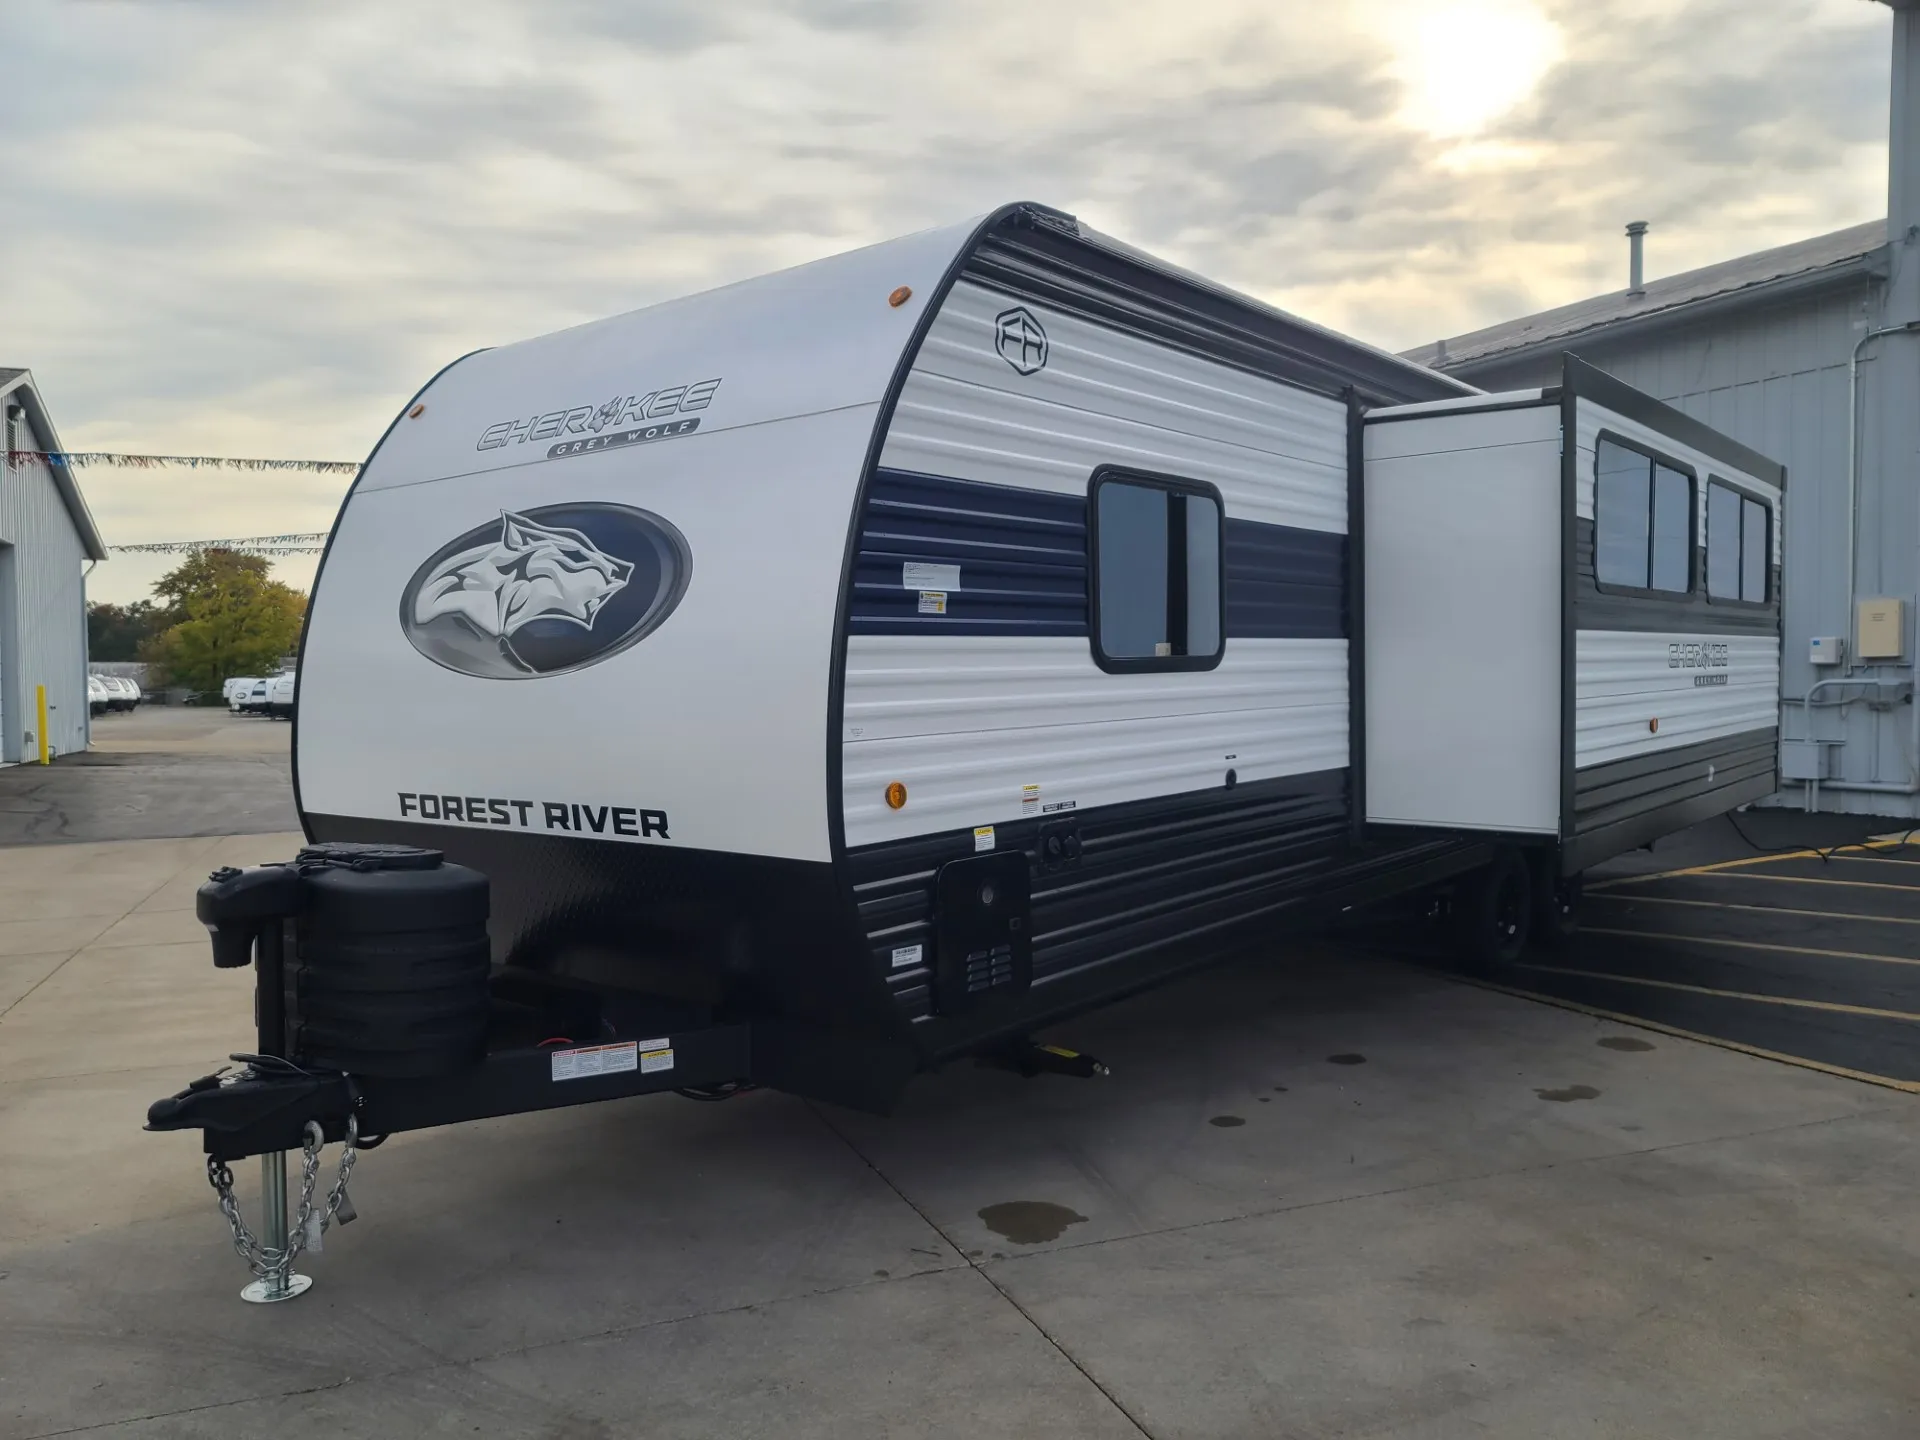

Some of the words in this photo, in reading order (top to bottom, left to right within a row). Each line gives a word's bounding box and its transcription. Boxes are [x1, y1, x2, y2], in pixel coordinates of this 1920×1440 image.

[556, 436, 612, 455] GREY
[627, 421, 691, 440] WOLF
[397, 792, 534, 827] FOREST
[541, 801, 671, 840] RIVER
